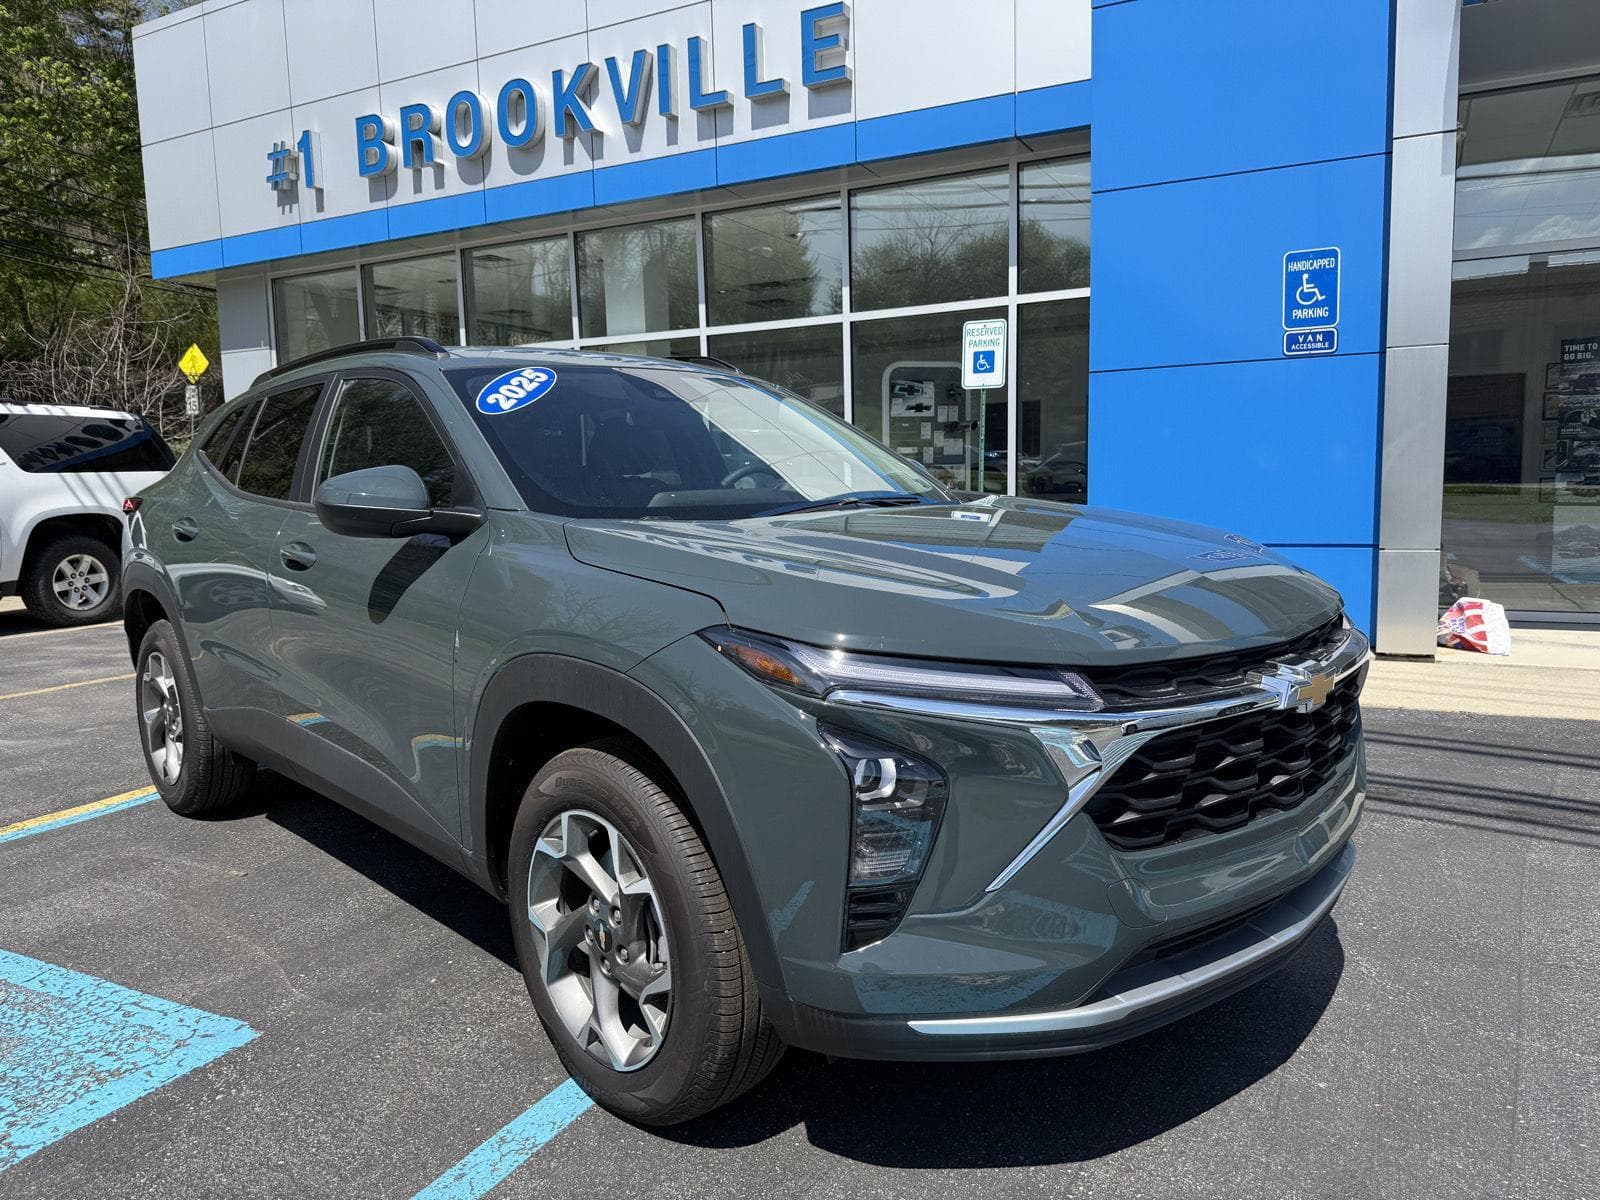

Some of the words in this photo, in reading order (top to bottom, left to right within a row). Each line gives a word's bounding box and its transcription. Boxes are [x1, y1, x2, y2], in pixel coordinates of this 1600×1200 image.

[267, 129, 321, 192] #1
[355, 1, 851, 179] BROOKVILLE
[1288, 258, 1335, 272] HANDICAPPED
[1292, 307, 1329, 320] PARKING
[966, 327, 1004, 337] RESERVED
[1298, 334, 1323, 342] VAN
[968, 338, 1000, 348] PARKING
[1291, 342, 1329, 350] ACCESSIBLE
[486, 368, 549, 410] 2025
[187, 400, 198, 412] 15
